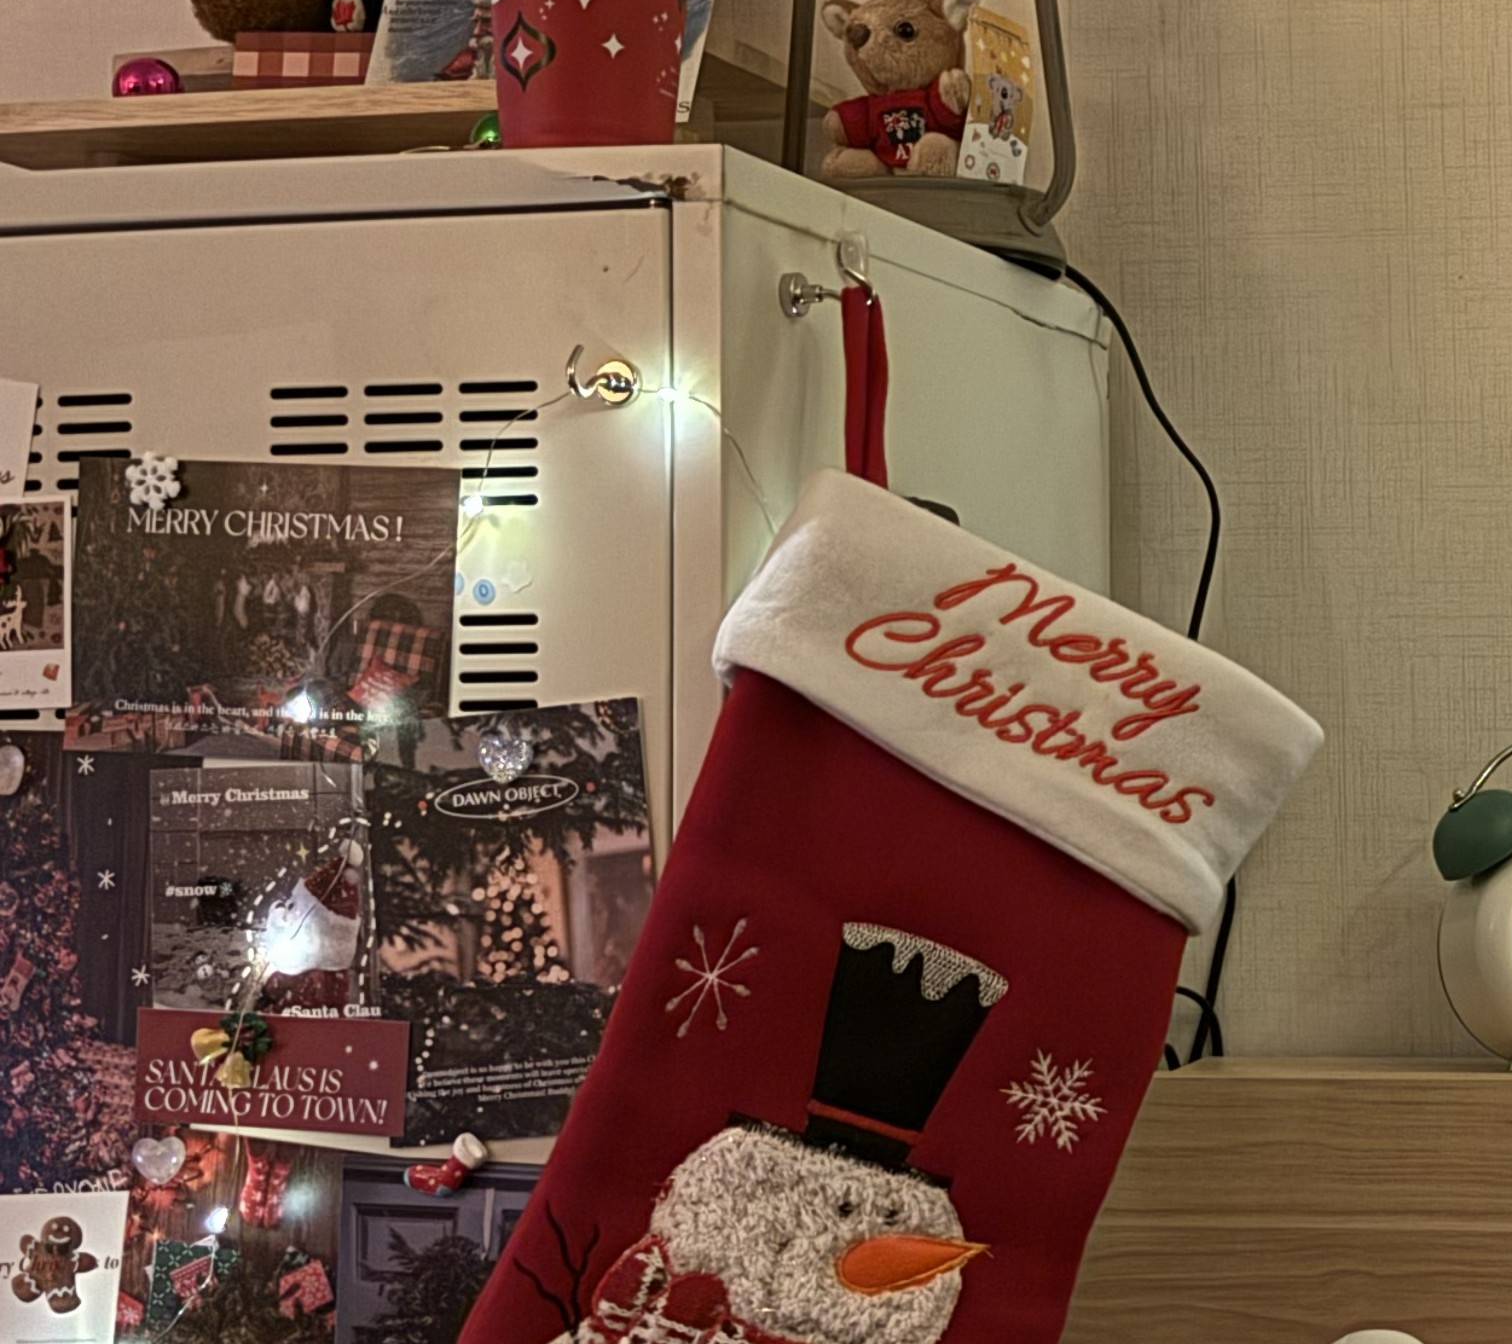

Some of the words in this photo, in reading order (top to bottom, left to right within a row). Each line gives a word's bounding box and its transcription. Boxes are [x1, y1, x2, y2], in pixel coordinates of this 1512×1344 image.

[127, 507, 219, 535] MERRY
[933, 562, 1201, 741] Merry
[115, 698, 169, 713] Christmas
[845, 611, 1214, 823] Christmas
[225, 787, 309, 803] Christmas
[452, 789, 501, 807] DAWN
[504, 784, 560, 802] OBJECT
[165, 885, 217, 897] #snow
[343, 1004, 382, 1017] Clau
[145, 1059, 228, 1087] SANT
[253, 1064, 316, 1093] LAUS
[319, 1067, 343, 1094] IS
[144, 1087, 250, 1116] COMING
[259, 1092, 294, 1118] TO
[301, 1094, 388, 1125] TOWN!
